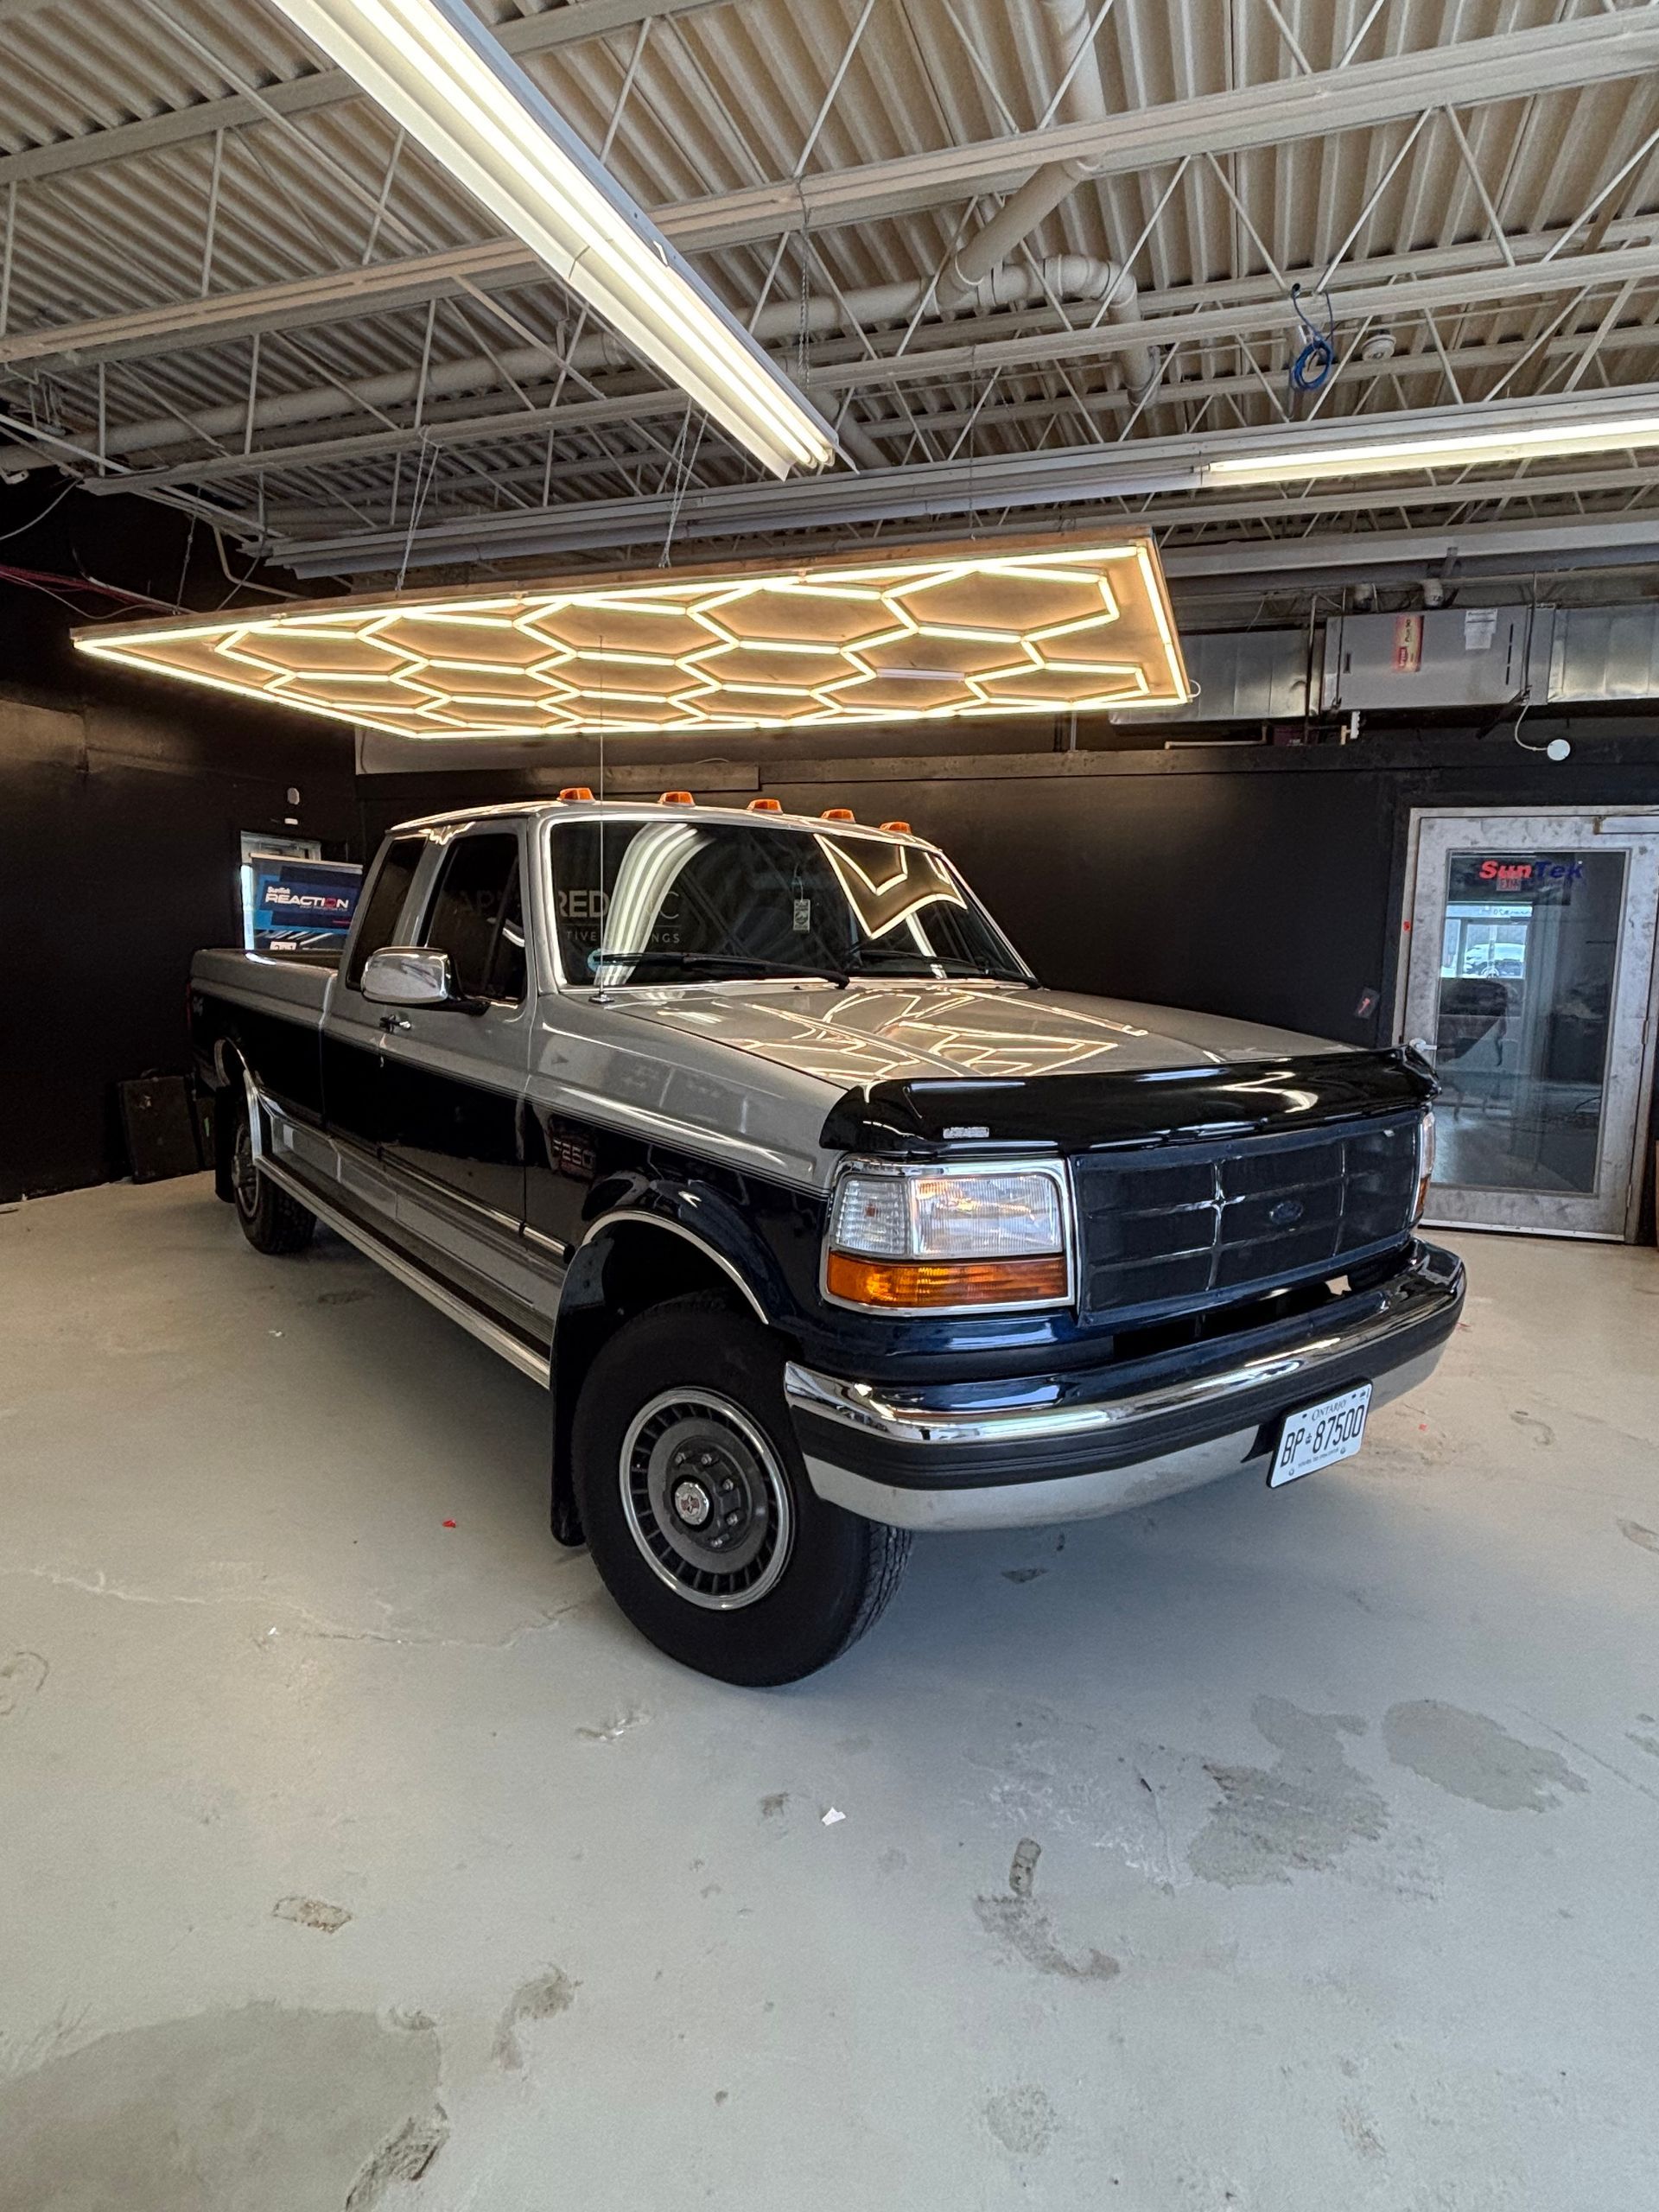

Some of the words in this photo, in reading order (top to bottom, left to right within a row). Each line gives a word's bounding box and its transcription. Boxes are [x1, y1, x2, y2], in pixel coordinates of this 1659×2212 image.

[1479, 860, 1584, 880] SunTek
[1311, 1399, 1347, 1422] ONTARIO
[1281, 1427, 1306, 1468] BP
[1312, 1404, 1365, 1454] 87500
